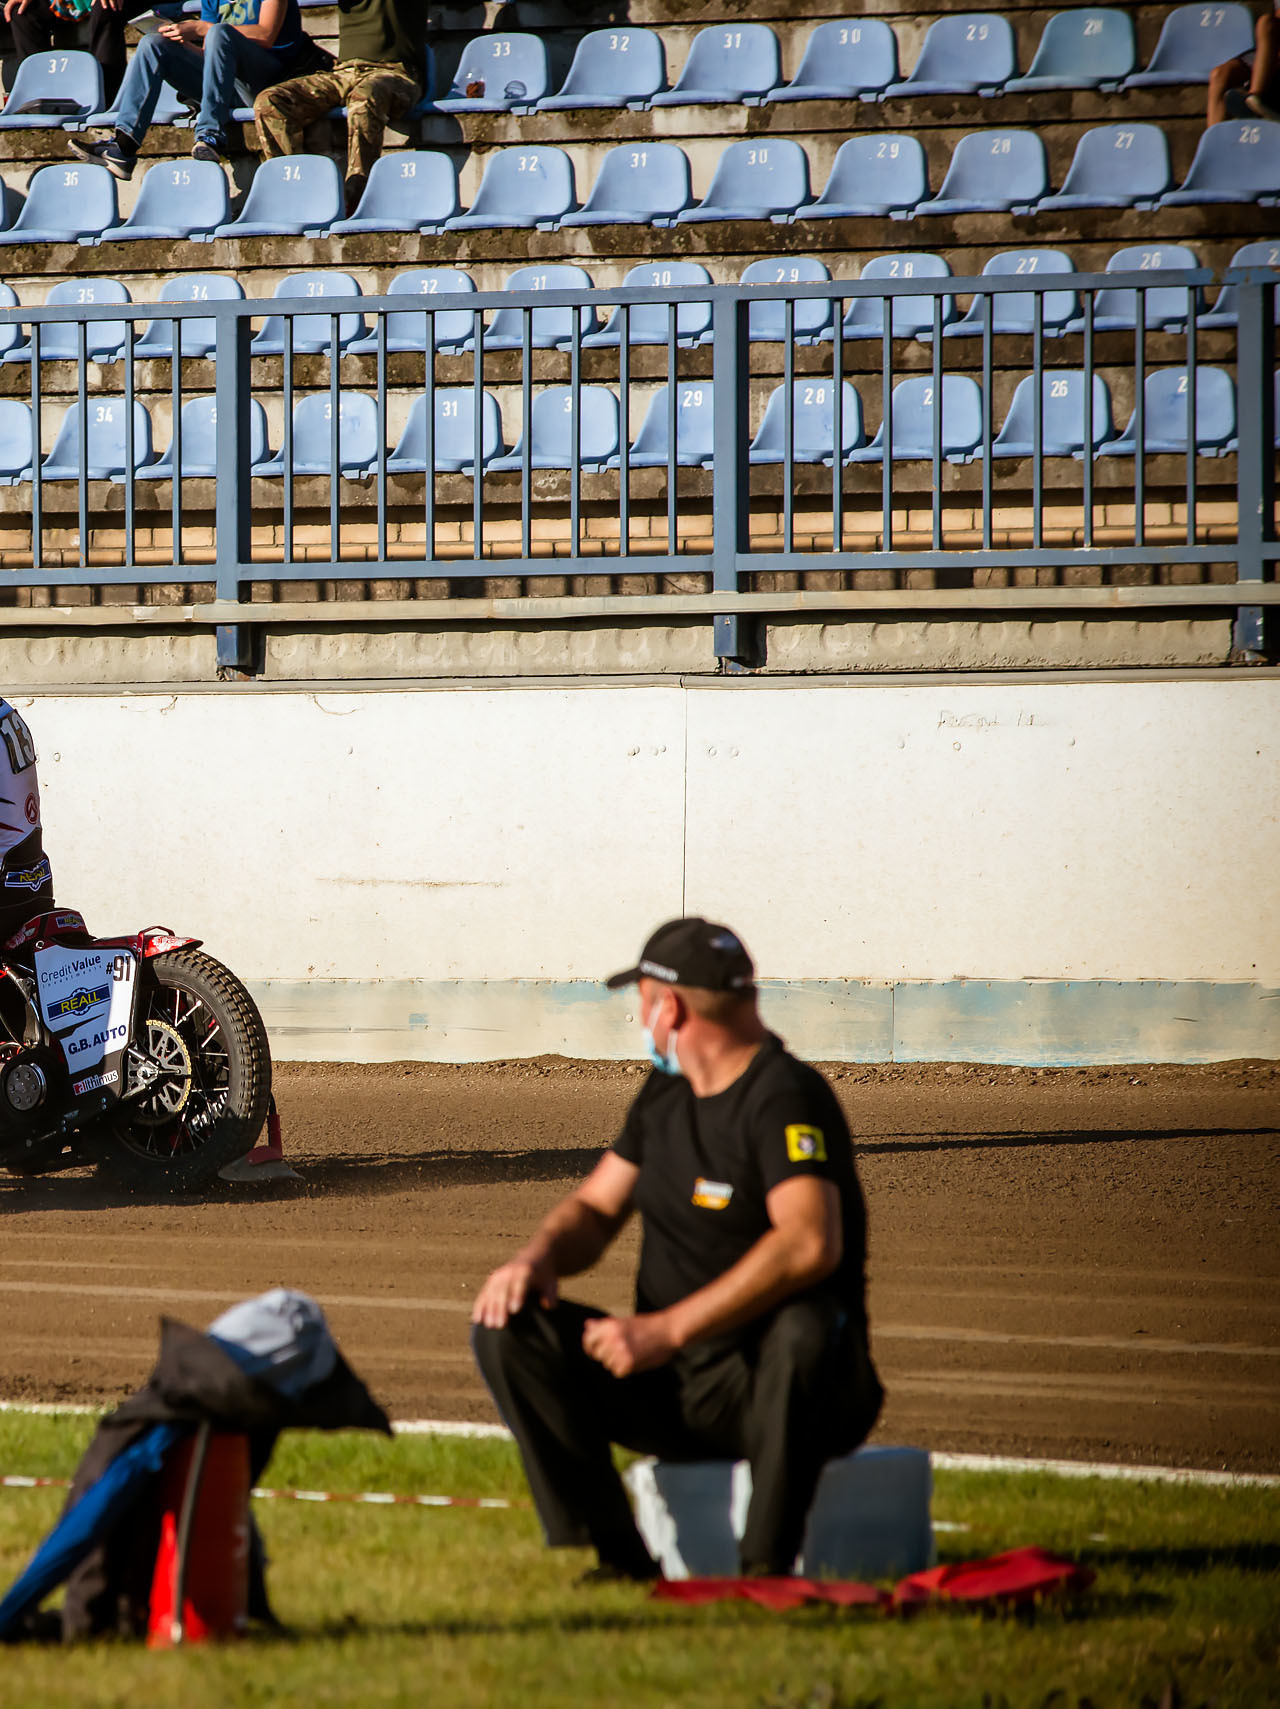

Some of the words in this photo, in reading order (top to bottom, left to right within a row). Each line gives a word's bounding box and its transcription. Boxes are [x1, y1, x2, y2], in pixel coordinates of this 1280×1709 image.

[1200, 9, 1226, 28] 27
[839, 29, 861, 45] 30
[966, 24, 990, 41] 29
[492, 42, 511, 57] 33
[609, 35, 630, 52] 32
[723, 33, 742, 50] 31
[48, 57, 69, 74] 37
[1114, 132, 1136, 149] 27
[1239, 126, 1261, 145] 26
[877, 142, 900, 159] 29
[991, 138, 1011, 155] 28
[518, 156, 538, 172] 32
[630, 152, 648, 168] 31
[748, 149, 768, 165] 30
[172, 169, 191, 186] 35
[282, 165, 301, 182] 34
[400, 162, 416, 178] 33
[64, 171, 79, 187] 36
[889, 261, 914, 278] 28
[1015, 257, 1039, 275] 27
[1140, 252, 1162, 270] 26
[531, 275, 547, 291] 31
[652, 270, 671, 287] 30
[776, 268, 799, 283] 29
[191, 285, 209, 301] 34
[420, 279, 438, 294] 32
[78, 288, 95, 304] 35
[803, 388, 825, 404] 28
[1051, 381, 1068, 398] 26
[683, 391, 703, 407] 29
[96, 407, 113, 423] 34
[442, 401, 458, 417] 31
[61, 992, 100, 1013] REALL
[68, 1038, 92, 1056] G.B.
[93, 1024, 127, 1047] AUTO
